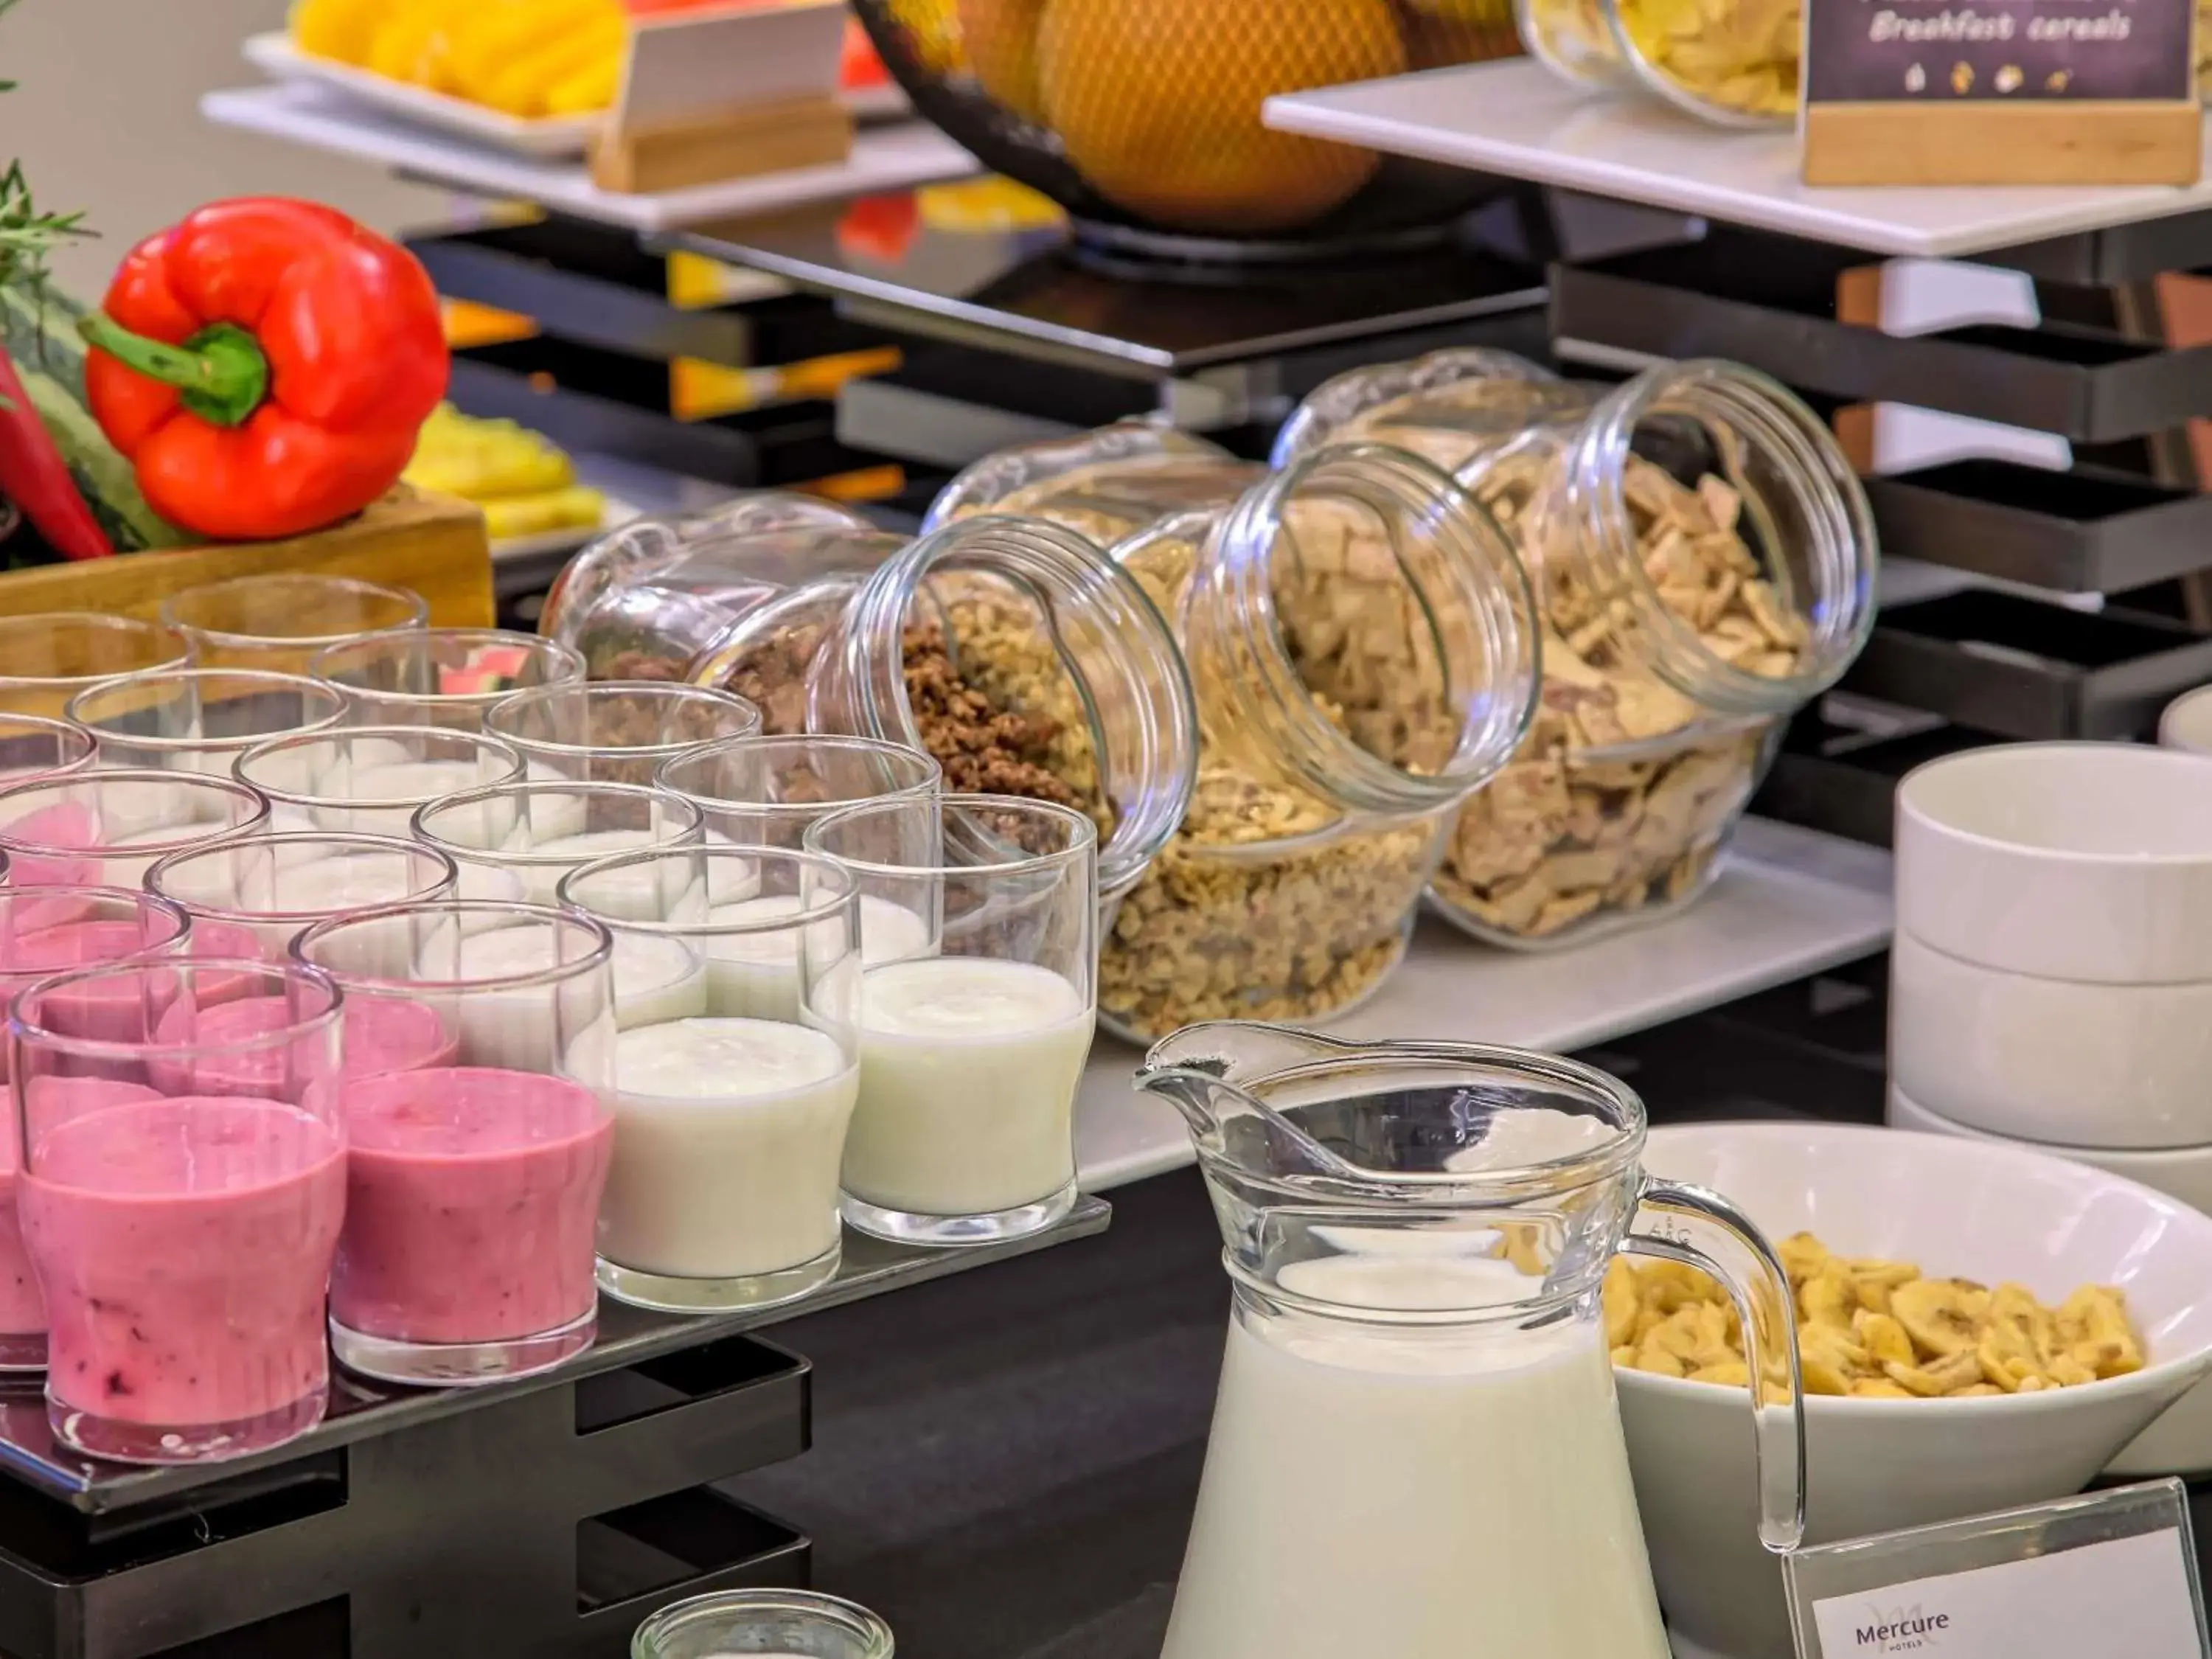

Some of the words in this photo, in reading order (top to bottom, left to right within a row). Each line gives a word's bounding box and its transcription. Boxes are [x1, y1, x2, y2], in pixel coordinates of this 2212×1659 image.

[1869, 10, 2016, 42] Breakfast
[2026, 8, 2131, 41] cereals
[1856, 1613, 1950, 1646] Mercure
[1888, 1639, 1923, 1652] HOTELS
